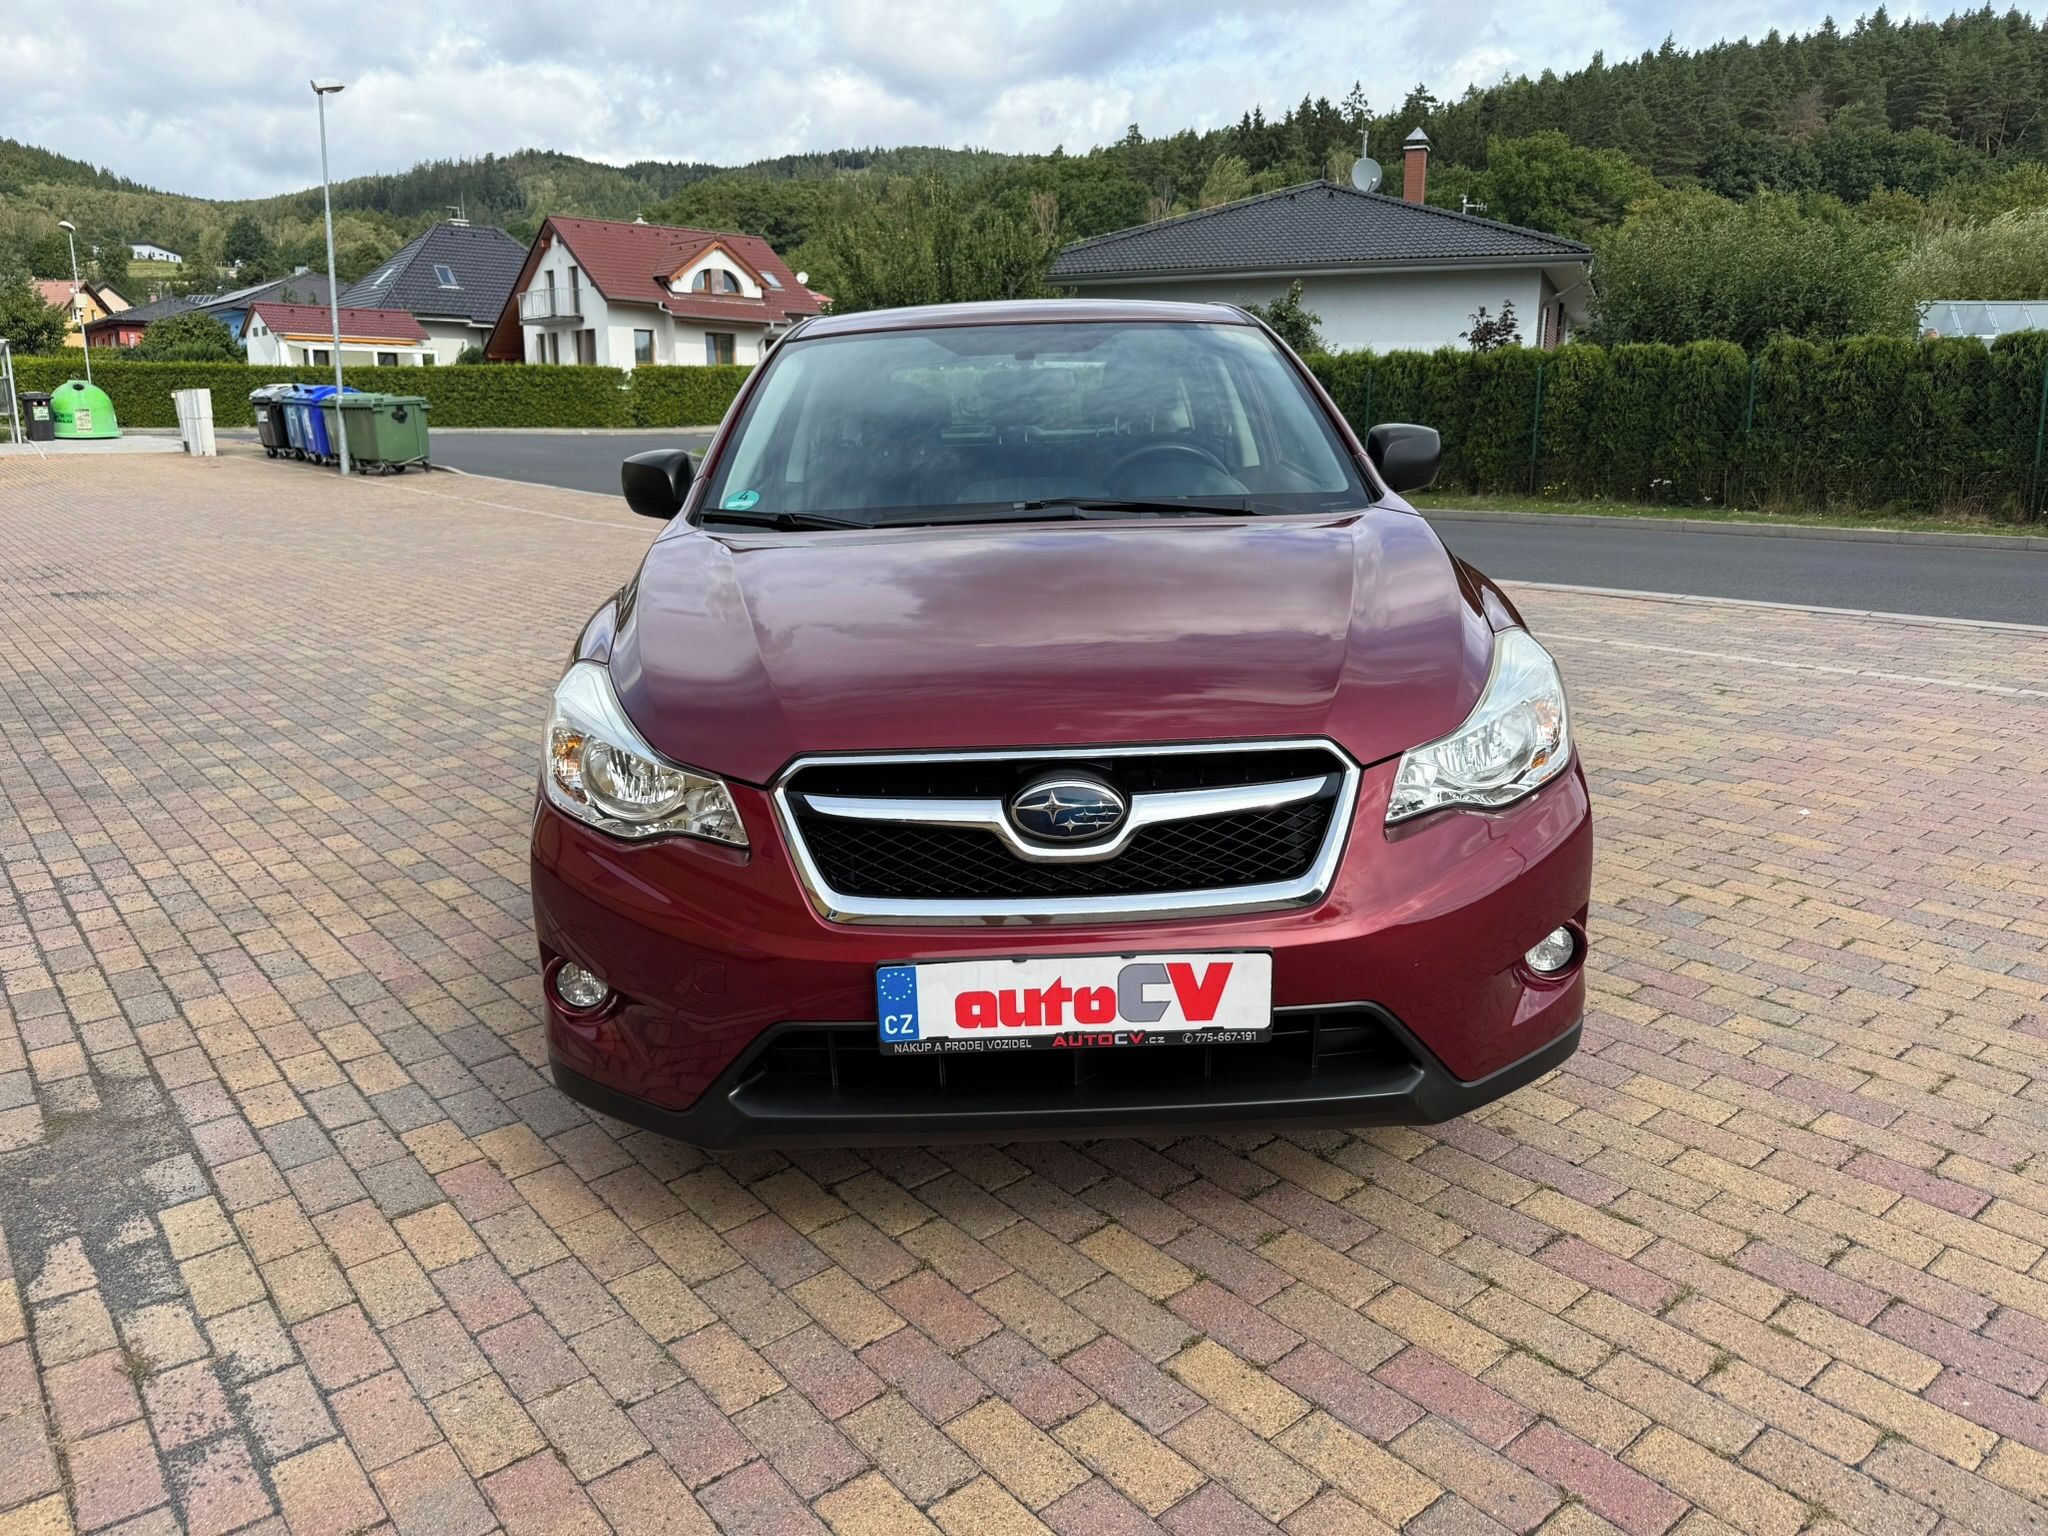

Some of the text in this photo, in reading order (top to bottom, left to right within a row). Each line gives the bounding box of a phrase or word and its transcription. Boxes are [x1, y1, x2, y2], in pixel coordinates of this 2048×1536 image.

[954, 962, 1234, 1029] autoCV
[884, 1013, 914, 1035] CZ
[894, 1039, 1032, 1053] NÁKUP A PRODEJ VOZIDEL
[1195, 1031, 1257, 1043] 775-667-191
